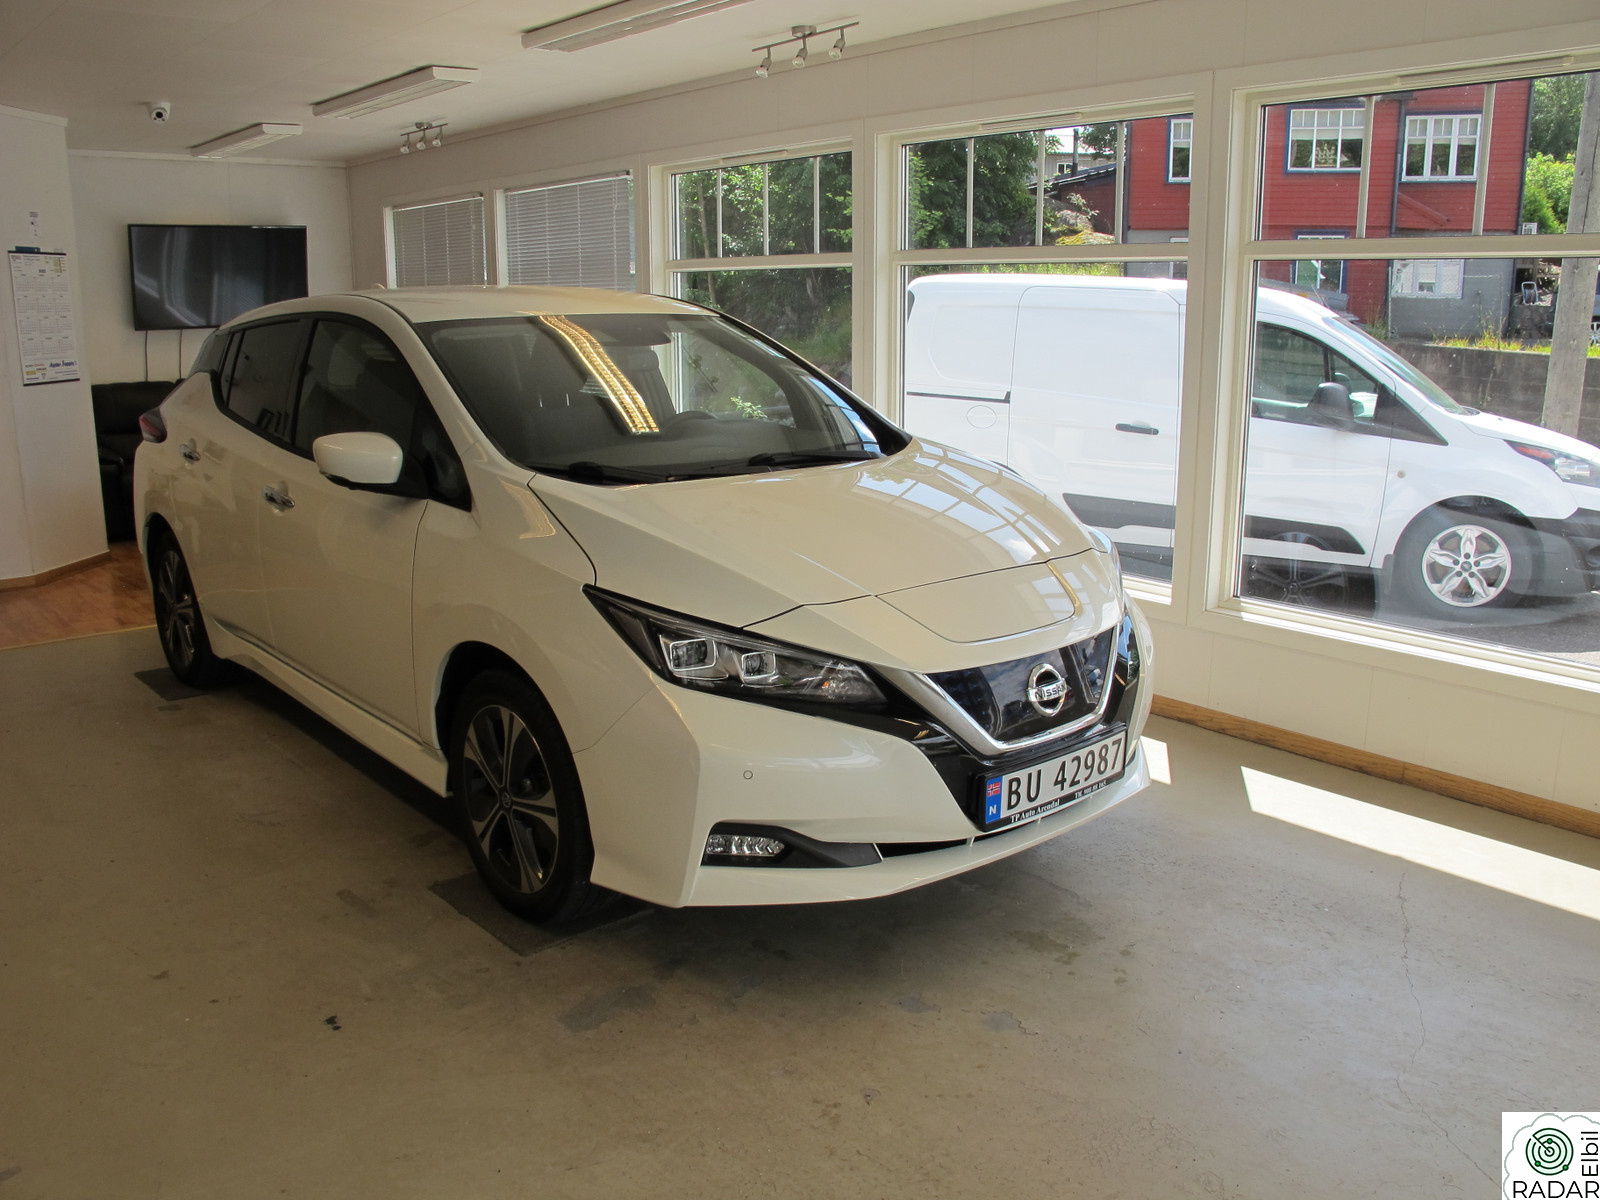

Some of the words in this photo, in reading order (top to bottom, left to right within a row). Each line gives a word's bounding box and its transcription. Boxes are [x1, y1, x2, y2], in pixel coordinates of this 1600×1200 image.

[1035, 684, 1065, 699] NISSAN
[1007, 769, 1042, 810] BU
[1053, 738, 1122, 792] 42987
[989, 804, 997, 815] N
[1010, 813, 1020, 823] TP
[1020, 809, 1036, 820] Auto
[1036, 798, 1060, 814] Arendal
